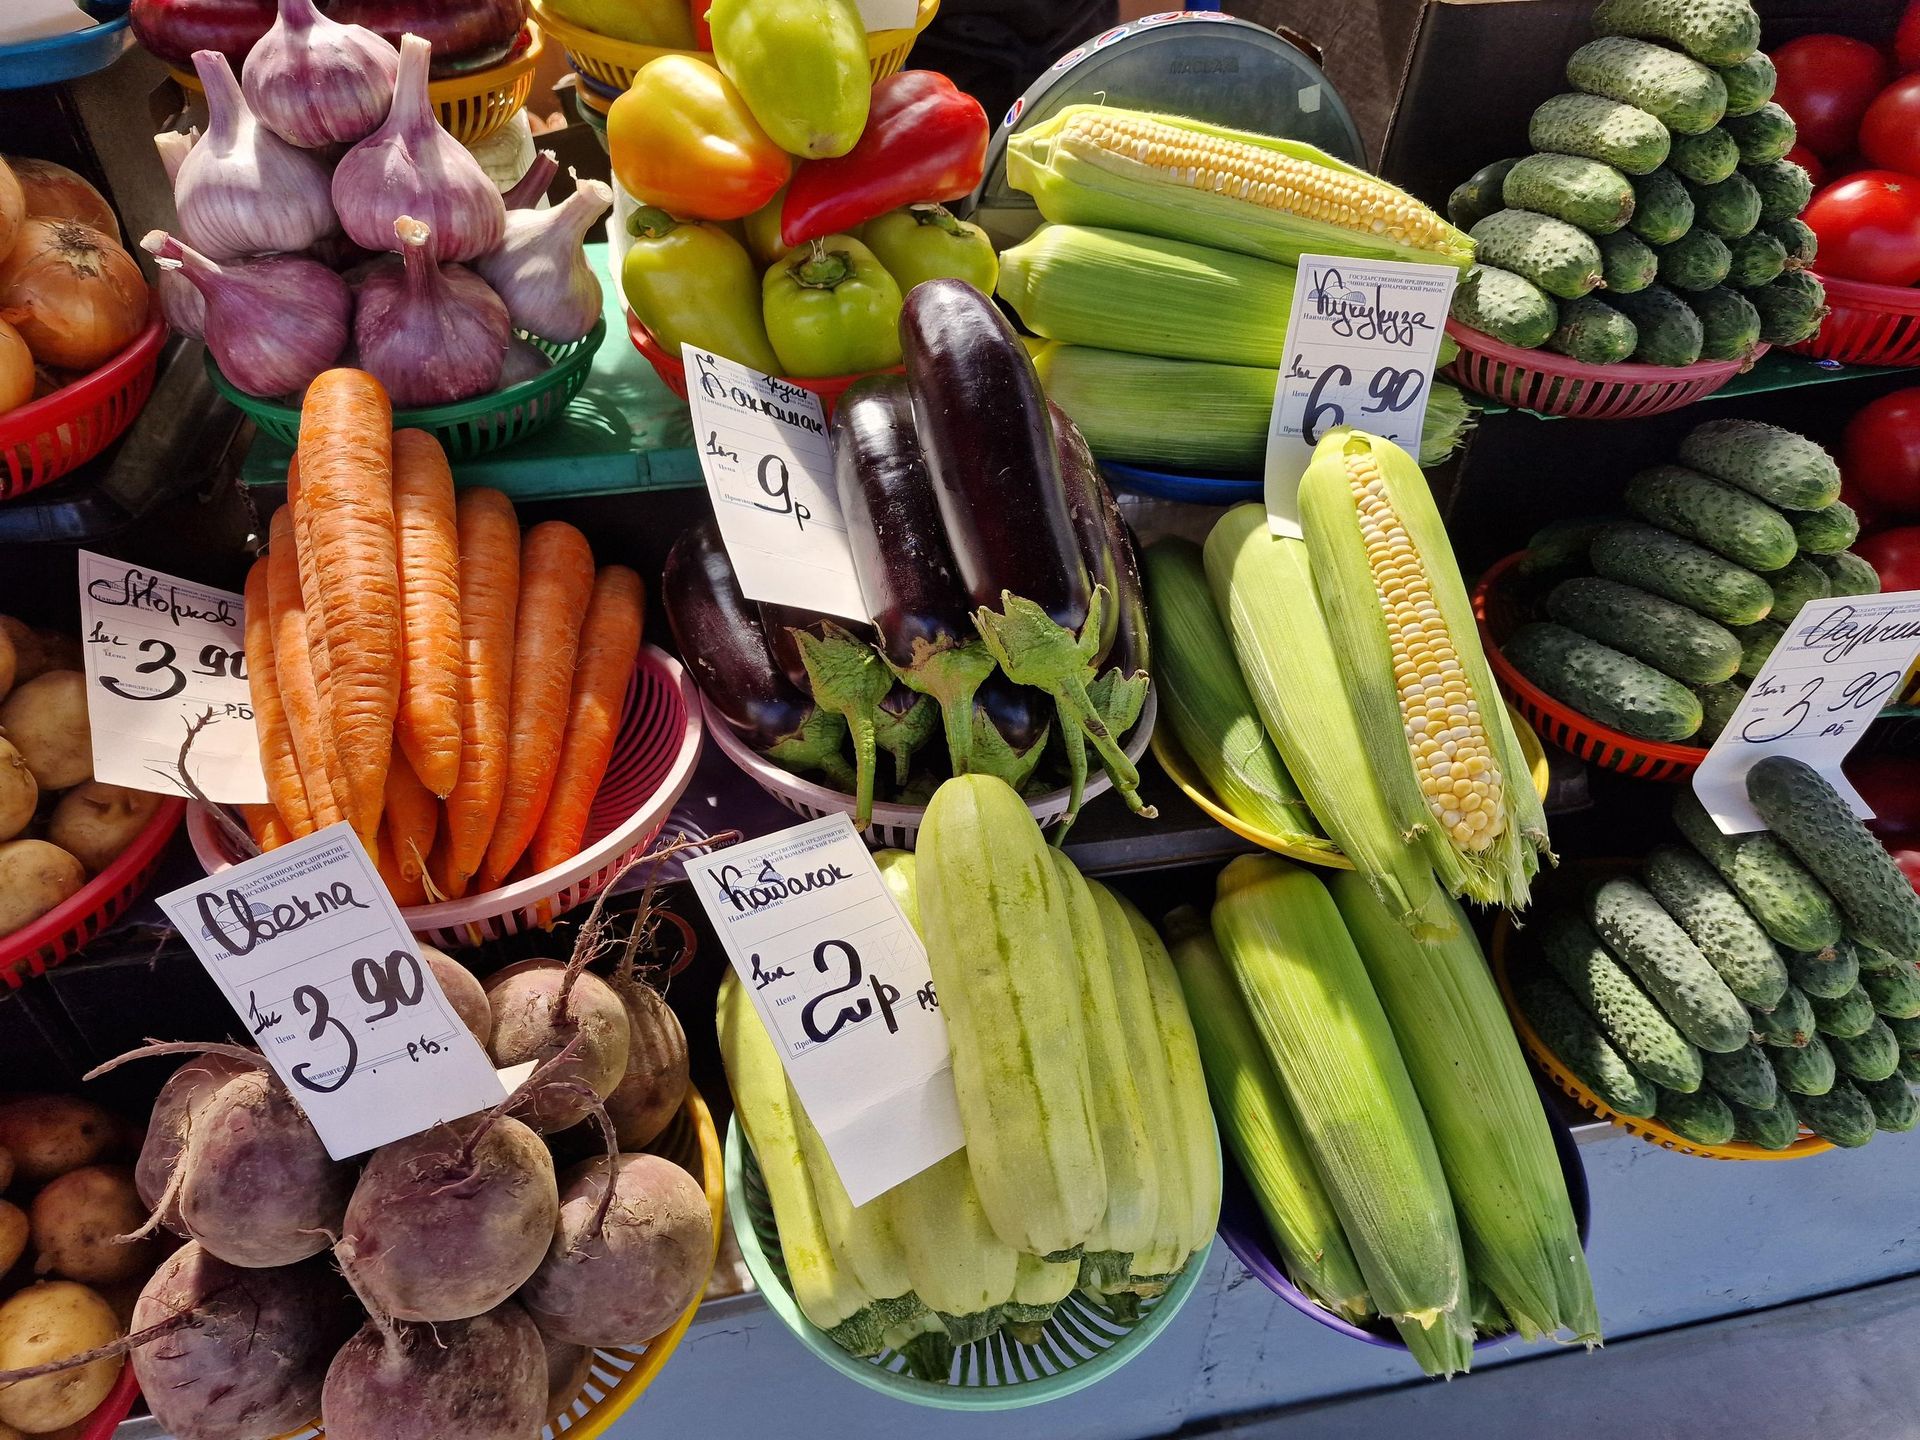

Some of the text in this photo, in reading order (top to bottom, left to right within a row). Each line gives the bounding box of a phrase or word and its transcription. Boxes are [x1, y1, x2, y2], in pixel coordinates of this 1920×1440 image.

[295, 845, 345, 869] ПРЕДПРИЯТИЕ
[270, 863, 323, 888] КОМАРОВСКИЙ
[275, 1032, 296, 1044] Цена
